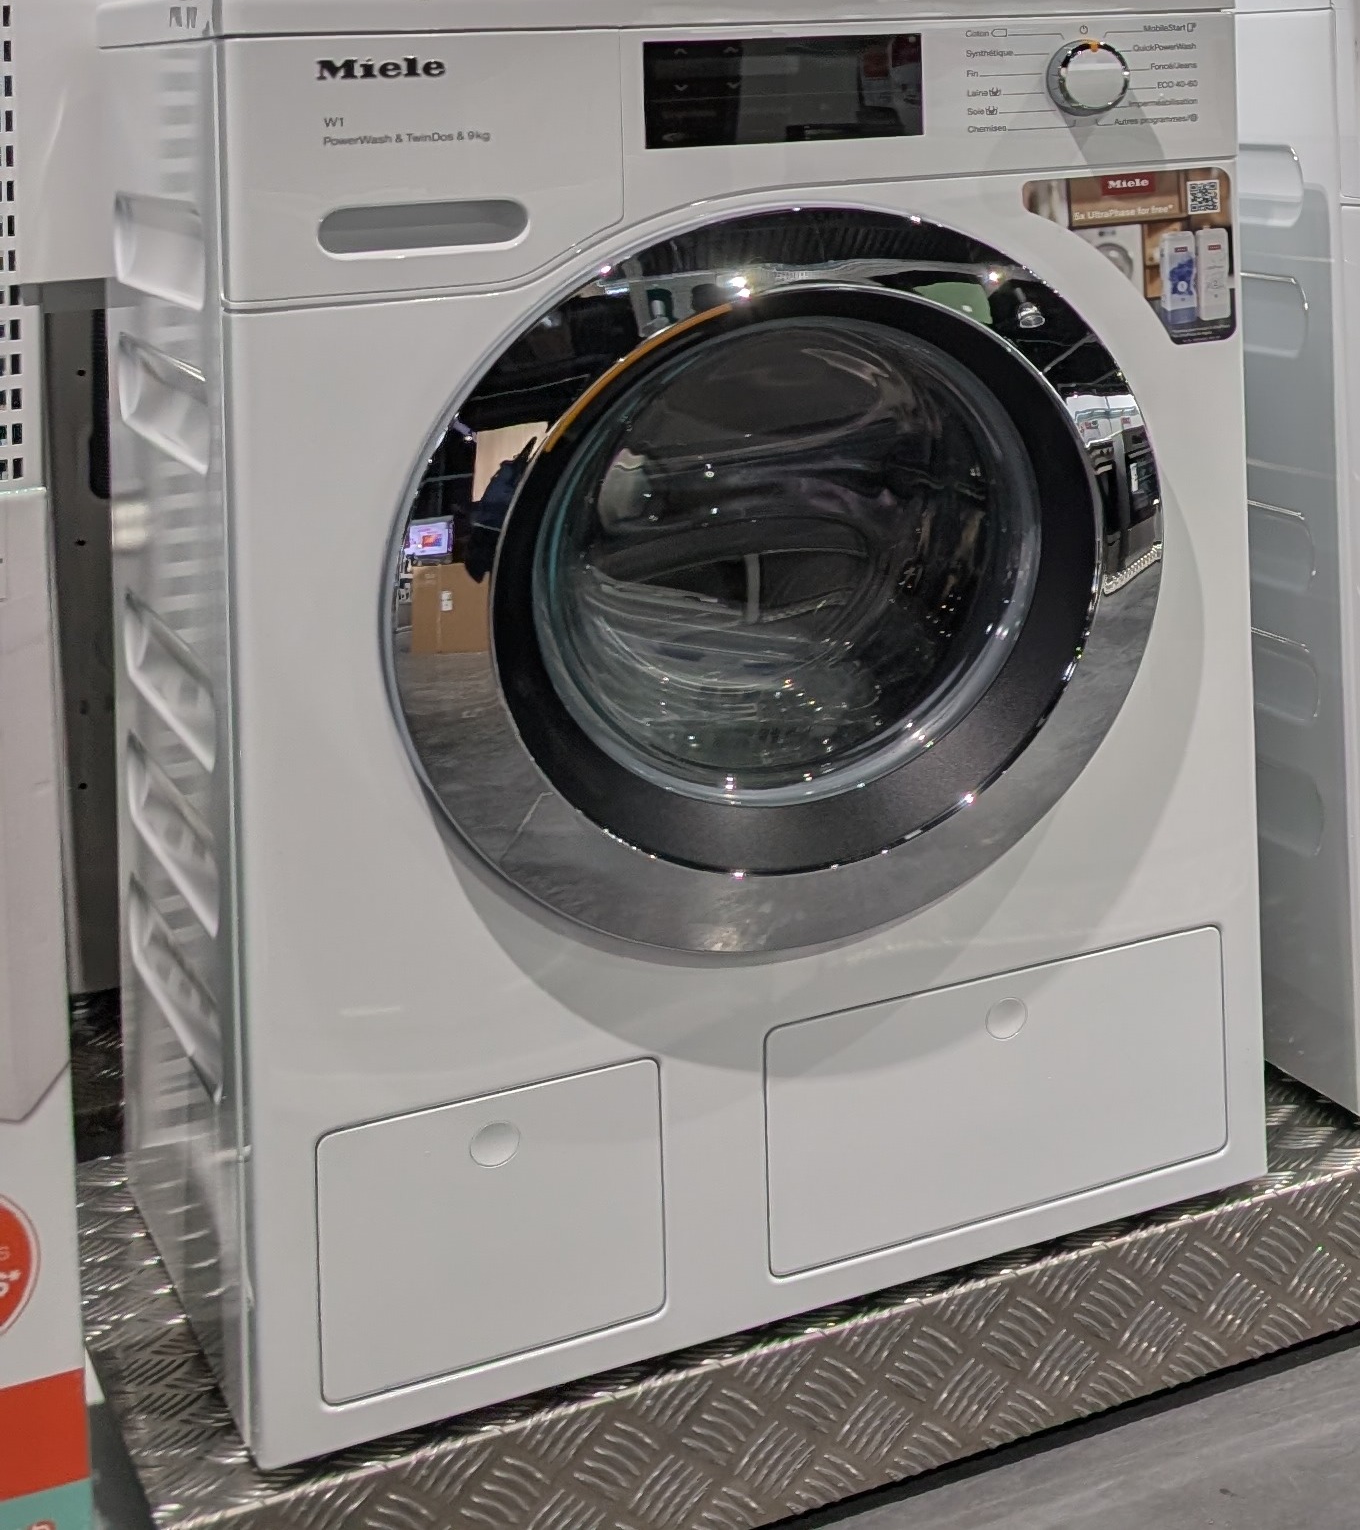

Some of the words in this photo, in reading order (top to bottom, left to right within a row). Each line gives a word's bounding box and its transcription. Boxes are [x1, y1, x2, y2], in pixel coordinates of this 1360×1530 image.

[965, 29, 989, 37] Coton
[1133, 43, 1197, 52] QuickPowerWash
[966, 49, 1014, 59] Synthétique
[316, 56, 447, 81] Miele
[966, 70, 979, 78] Fin
[1157, 80, 1173, 89] ECO
[323, 116, 345, 128] W1
[323, 134, 393, 147] PowerWash
[394, 133, 404, 144] &
[405, 132, 454, 143] TwinDos
[456, 131, 464, 142] &
[467, 130, 491, 144] 9kg
[1107, 178, 1150, 190] Miele
[1087, 208, 1137, 220] UltraPhase
[1137, 206, 1150, 215] for
